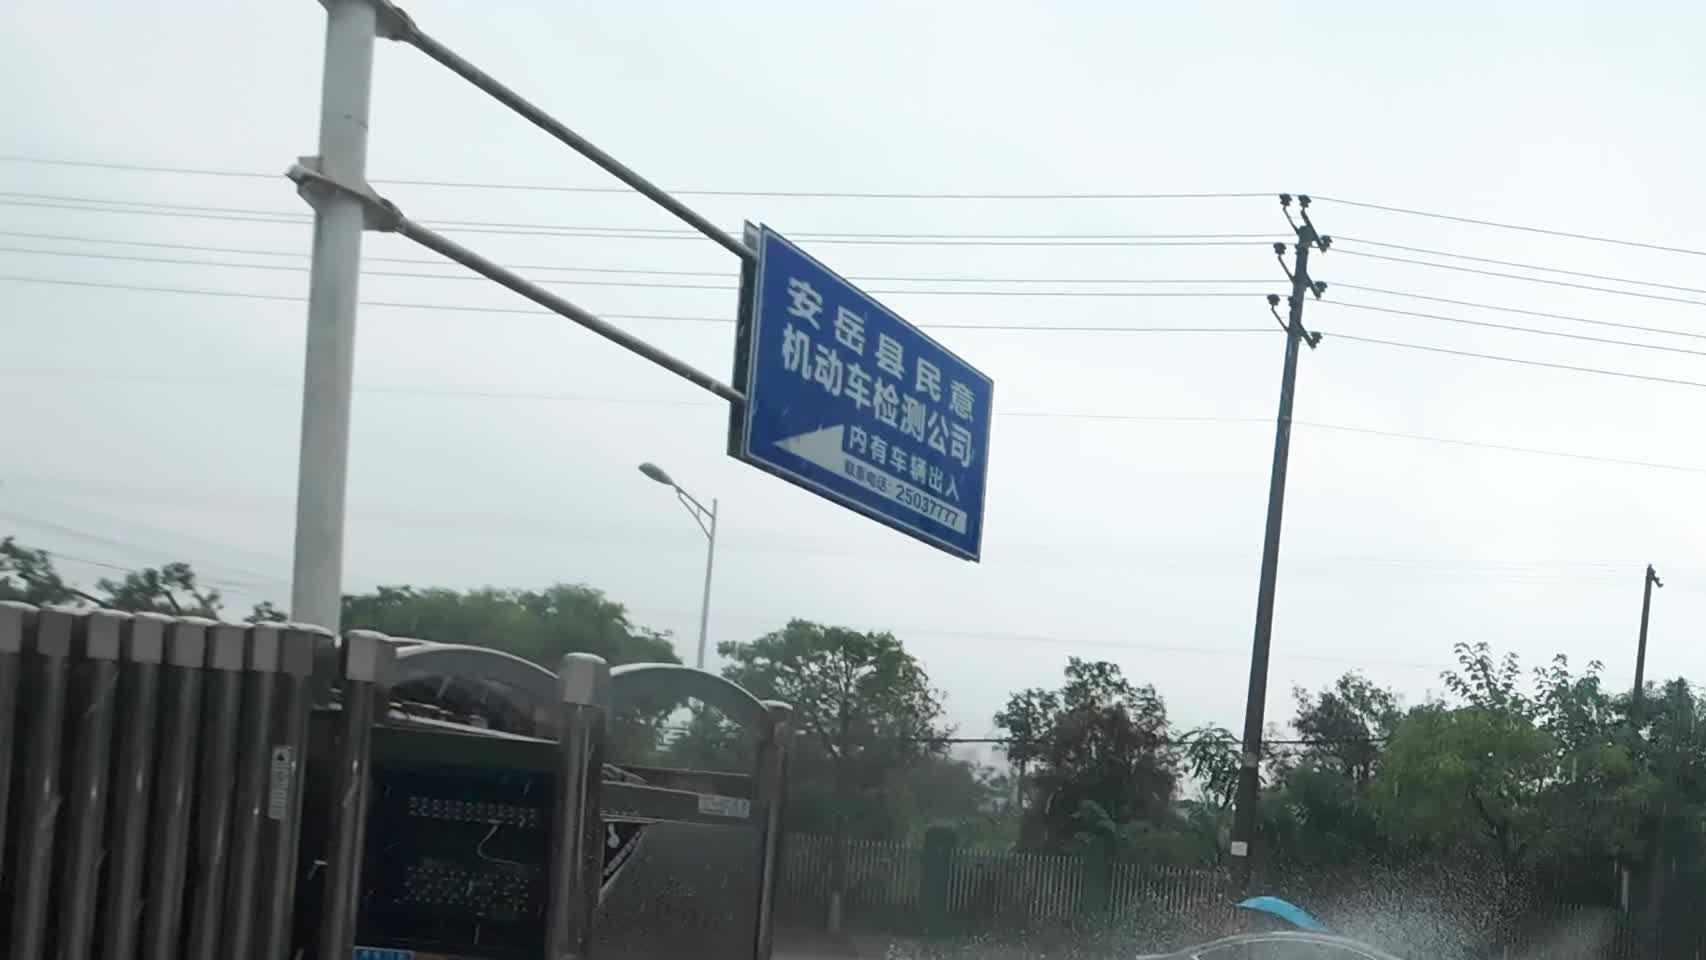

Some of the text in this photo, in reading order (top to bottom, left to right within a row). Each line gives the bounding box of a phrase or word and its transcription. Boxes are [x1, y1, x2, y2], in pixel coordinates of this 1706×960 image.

[781, 323, 973, 468] 机动车检测公司
[787, 277, 975, 422] 安岳县民意
[850, 426, 959, 501] 内有车辆出入
